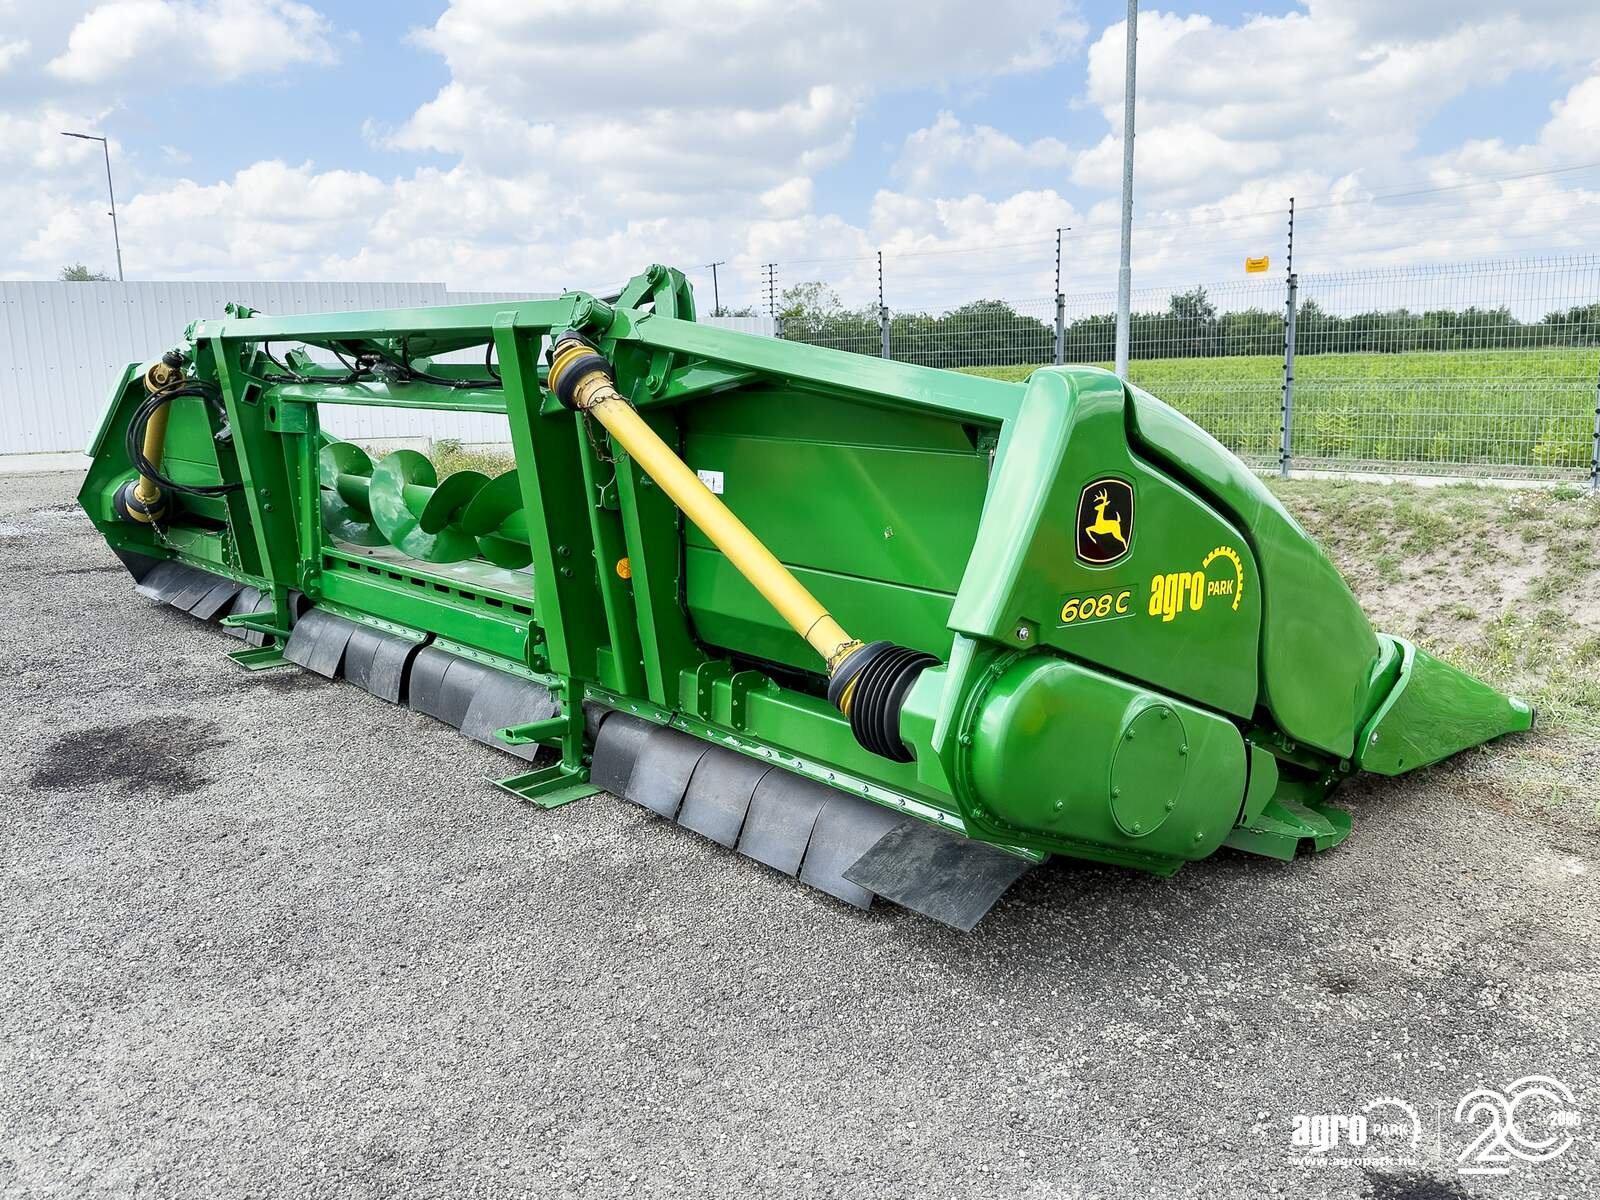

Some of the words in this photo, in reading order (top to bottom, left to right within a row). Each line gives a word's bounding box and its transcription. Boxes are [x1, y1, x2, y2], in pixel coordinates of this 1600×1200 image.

[1060, 593, 1113, 623] 608
[1115, 591, 1131, 613] C
[1148, 570, 1206, 622] agro
[1207, 580, 1234, 596] PARK
